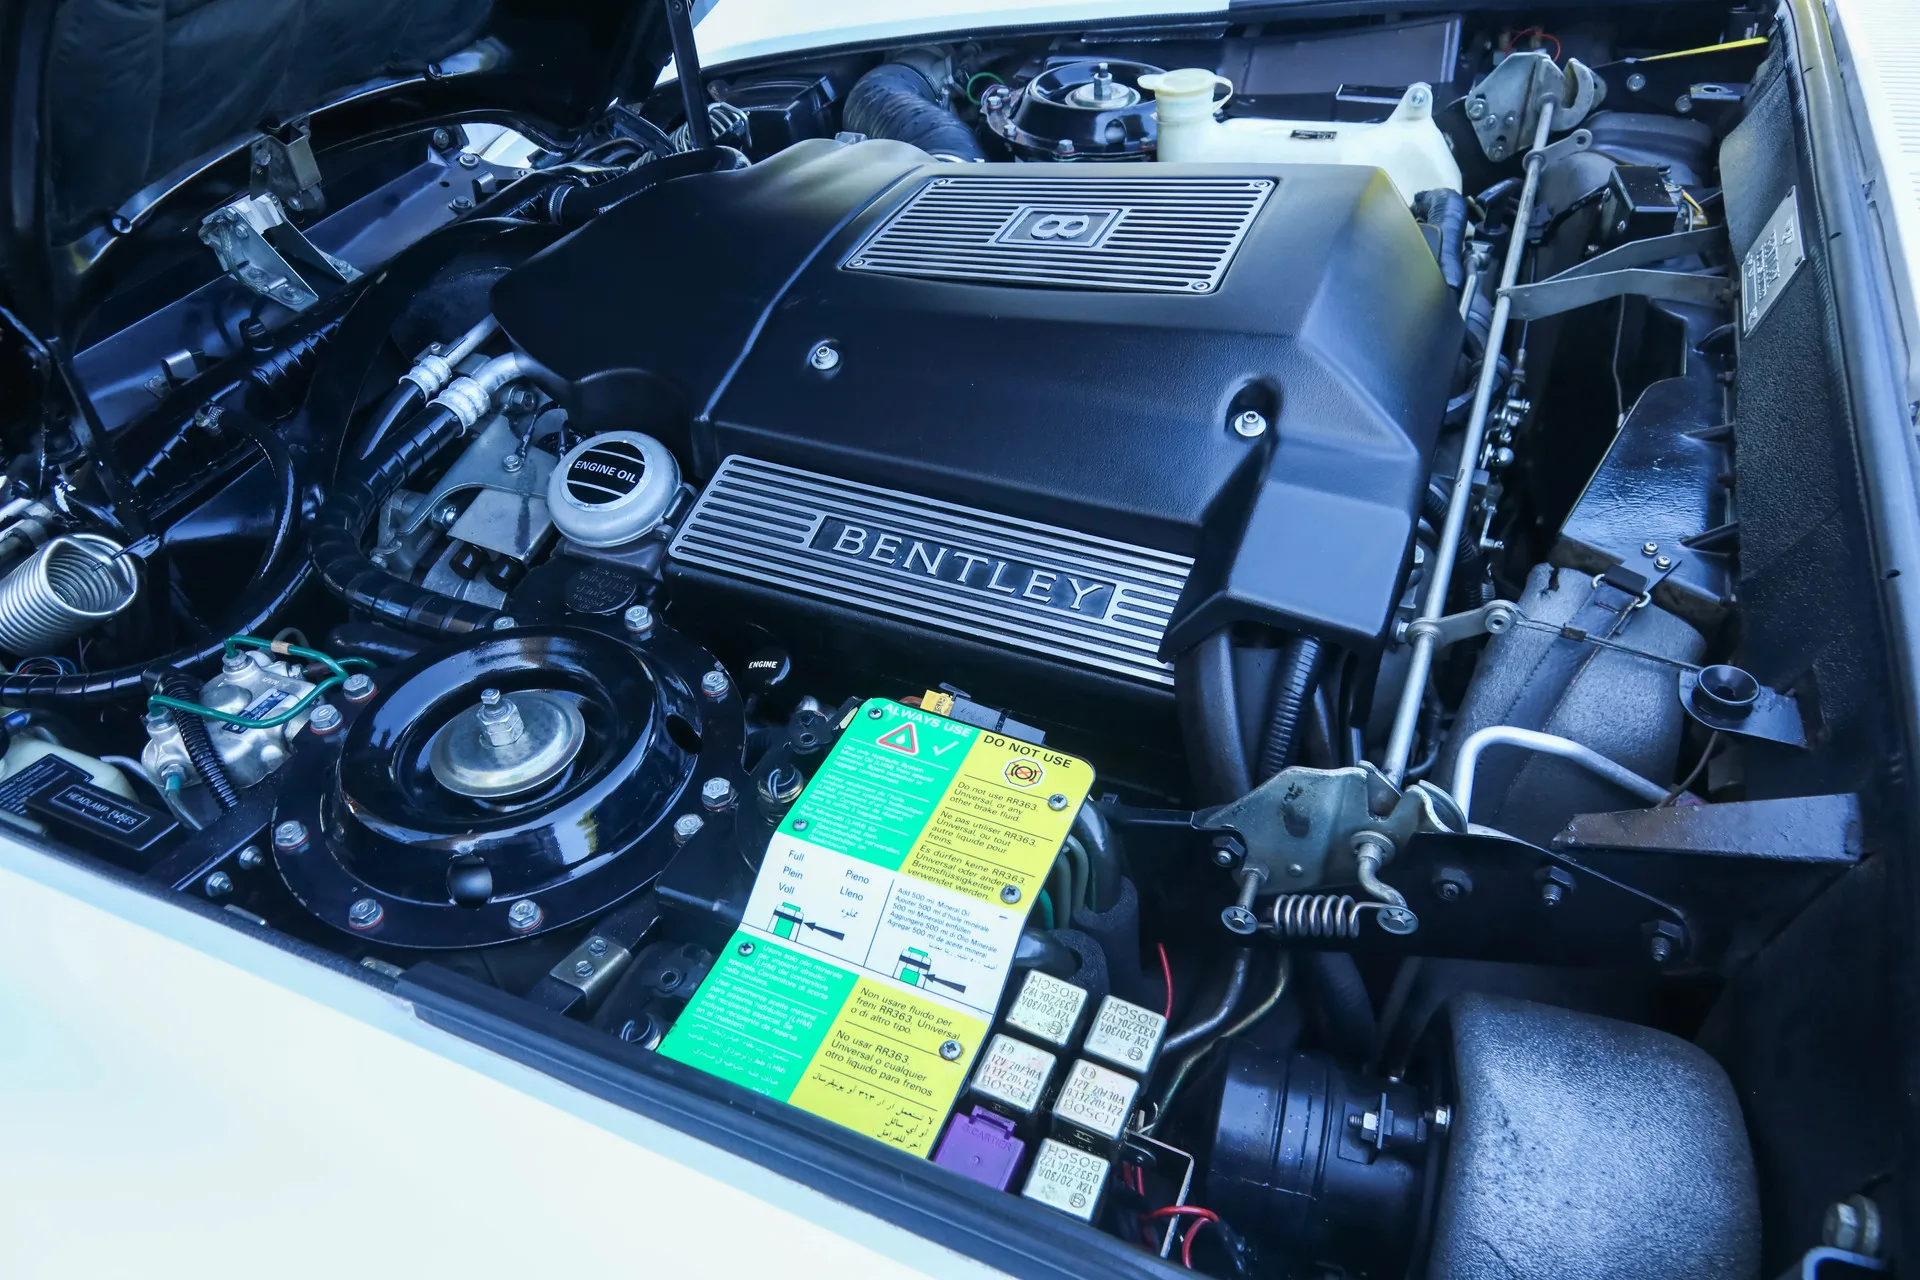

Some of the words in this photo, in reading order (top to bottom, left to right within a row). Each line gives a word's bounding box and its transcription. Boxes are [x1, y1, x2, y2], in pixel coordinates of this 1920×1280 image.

[574, 460, 617, 476] ENGINE
[617, 469, 636, 484] OIL
[833, 524, 1103, 609] BENTLEY
[748, 660, 778, 669] ENGINE
[884, 703, 941, 728] ALWAYS
[943, 722, 972, 738] USE
[983, 734, 1005, 747] DO
[1008, 742, 1040, 757] NOT
[1043, 753, 1072, 768] USE
[957, 781, 970, 790] Do
[971, 787, 986, 795] not
[988, 792, 1004, 800] use
[66, 792, 109, 812] HEADLAMP
[949, 796, 972, 806] other
[973, 803, 997, 815] brake
[999, 810, 1019, 822] fluid.
[1007, 806, 1023, 815] any
[939, 810, 953, 819] Ne
[954, 816, 970, 825] pas
[972, 822, 1001, 834] utiliser
[927, 831, 951, 844] freins.
[931, 826, 953, 836] autre
[955, 832, 984, 846] liquide
[985, 843, 1007, 853] pour
[979, 832, 991, 840] ou
[993, 836, 1011, 846] tout
[788, 849, 804, 861] Full
[915, 852, 956, 870] Universal
[957, 867, 977, 877] oder
[919, 844, 930, 853] Es
[964, 859, 989, 872] keine
[782, 865, 803, 879] Plein
[845, 869, 869, 884] Pieno
[907, 868, 953, 887] verwendet
[778, 882, 794, 894] Voll
[839, 886, 863, 901] Lleno
[897, 887, 910, 896] Add
[911, 891, 925, 901] 500
[892, 902, 906, 912] 500
[918, 902, 931, 912] 500
[912, 927, 925, 936] 500
[925, 922, 939, 932] 500
[1030, 975, 1079, 1004] BOSCH
[860, 987, 879, 999] Non
[881, 997, 906, 1010] usare
[908, 1005, 934, 1020] fluido
[935, 1017, 952, 1027] per
[1108, 1001, 1159, 1027] BOSCH
[856, 996, 876, 1009] freni
[917, 1019, 960, 1040] Universal
[858, 1009, 868, 1017] di
[869, 1014, 890, 1026] altro
[893, 1022, 911, 1034] tipo.
[836, 1029, 850, 1041] No
[852, 1038, 872, 1049] usar
[1099, 1021, 1131, 1041] 20/30A
[1133, 1035, 1149, 1049] 12V
[831, 1039, 874, 1061] Universal
[883, 1061, 926, 1081] cualquier
[824, 1050, 844, 1061] otro
[878, 1071, 900, 1084] para
[902, 1078, 932, 1096] frenos
[981, 1074, 1034, 1104] BOSCH
[1046, 1143, 1101, 1172] BOSCH
[1038, 1166, 1073, 1187] 20/30A
